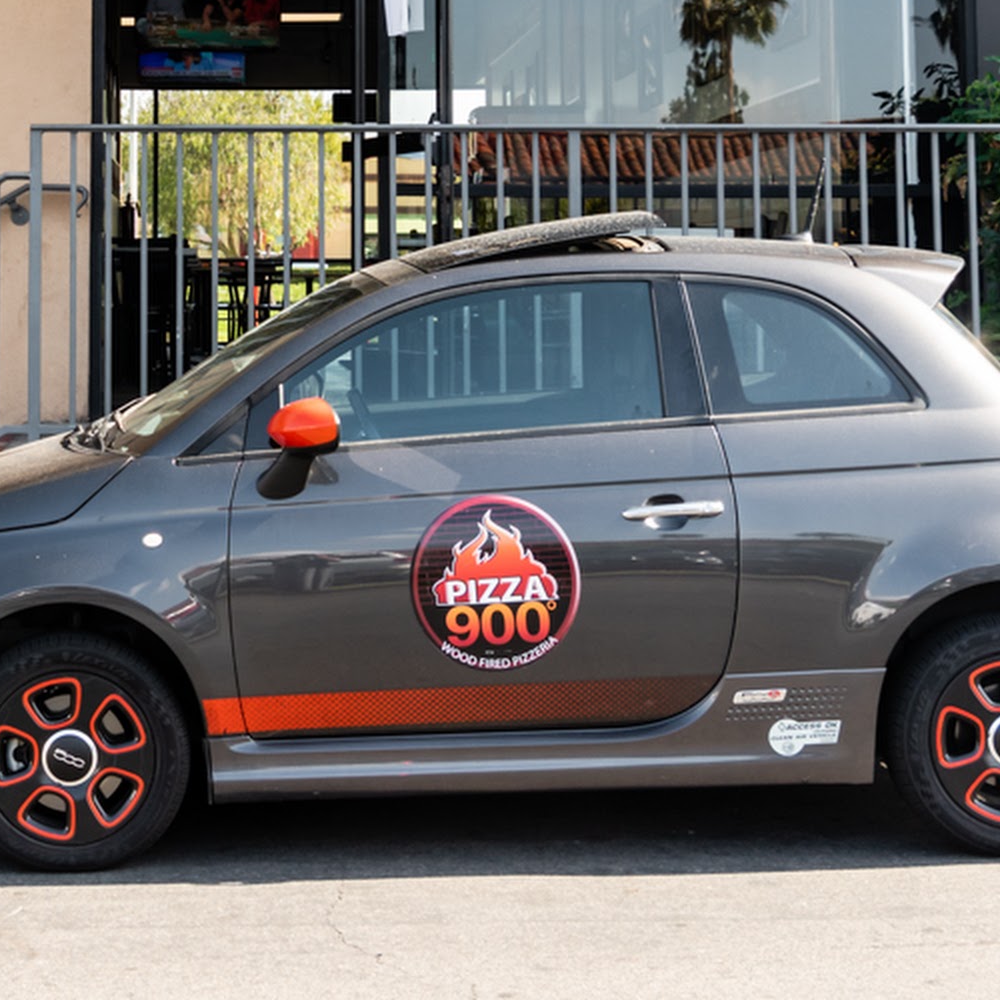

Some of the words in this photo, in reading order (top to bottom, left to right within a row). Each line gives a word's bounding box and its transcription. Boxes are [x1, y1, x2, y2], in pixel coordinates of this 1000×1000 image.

[445, 575, 549, 605] PIZZA
[441, 641, 478, 667] WOOD
[478, 657, 512, 670] FIRED
[511, 635, 559, 667] PIZZERIA
